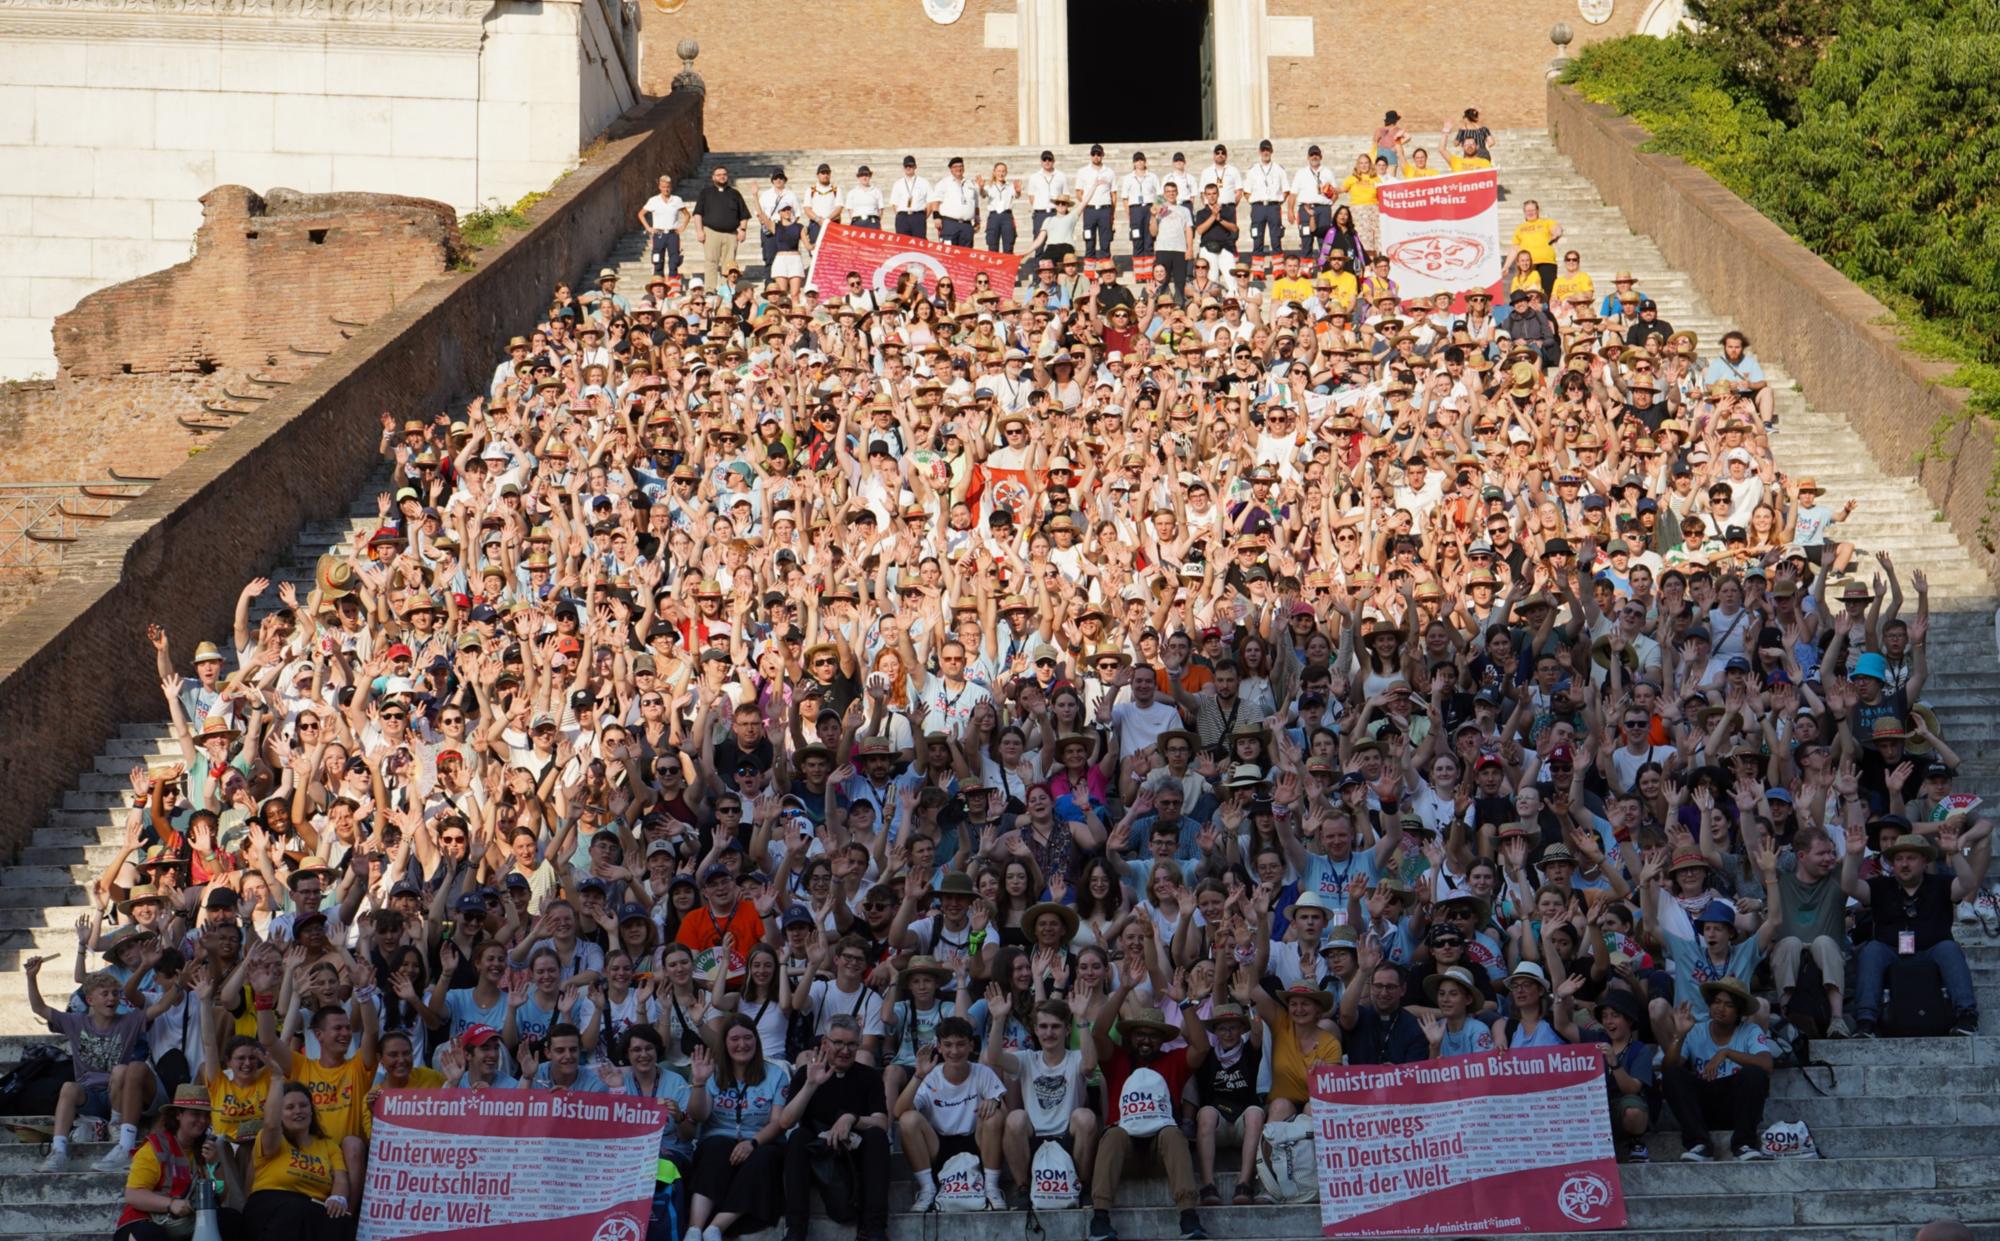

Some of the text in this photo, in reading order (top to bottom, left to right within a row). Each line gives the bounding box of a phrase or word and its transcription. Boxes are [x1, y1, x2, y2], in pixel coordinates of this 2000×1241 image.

[1382, 195, 1467, 209] Bistum Mainz
[842, 230, 901, 243] PFARREI
[1463, 1060, 1485, 1081] im
[1489, 1056, 1545, 1077] Bistum
[1548, 1051, 1596, 1074] Mainz
[528, 1097, 548, 1118] im
[552, 1098, 608, 1121] Bistum
[613, 1102, 661, 1125] Mainz
[1122, 1091, 1152, 1105] ROM
[1122, 1101, 1155, 1116] 2024
[1322, 1115, 1424, 1139] Unterwegs
[378, 1140, 478, 1169] Unterwegs
[1325, 1146, 1343, 1169] in
[1347, 1131, 1463, 1168] Deutschland
[374, 1167, 511, 1196] in Deutschland
[1035, 1169, 1067, 1181] ROM
[1328, 1163, 1451, 1198] und der Welt
[369, 1198, 492, 1224] und der Welt
